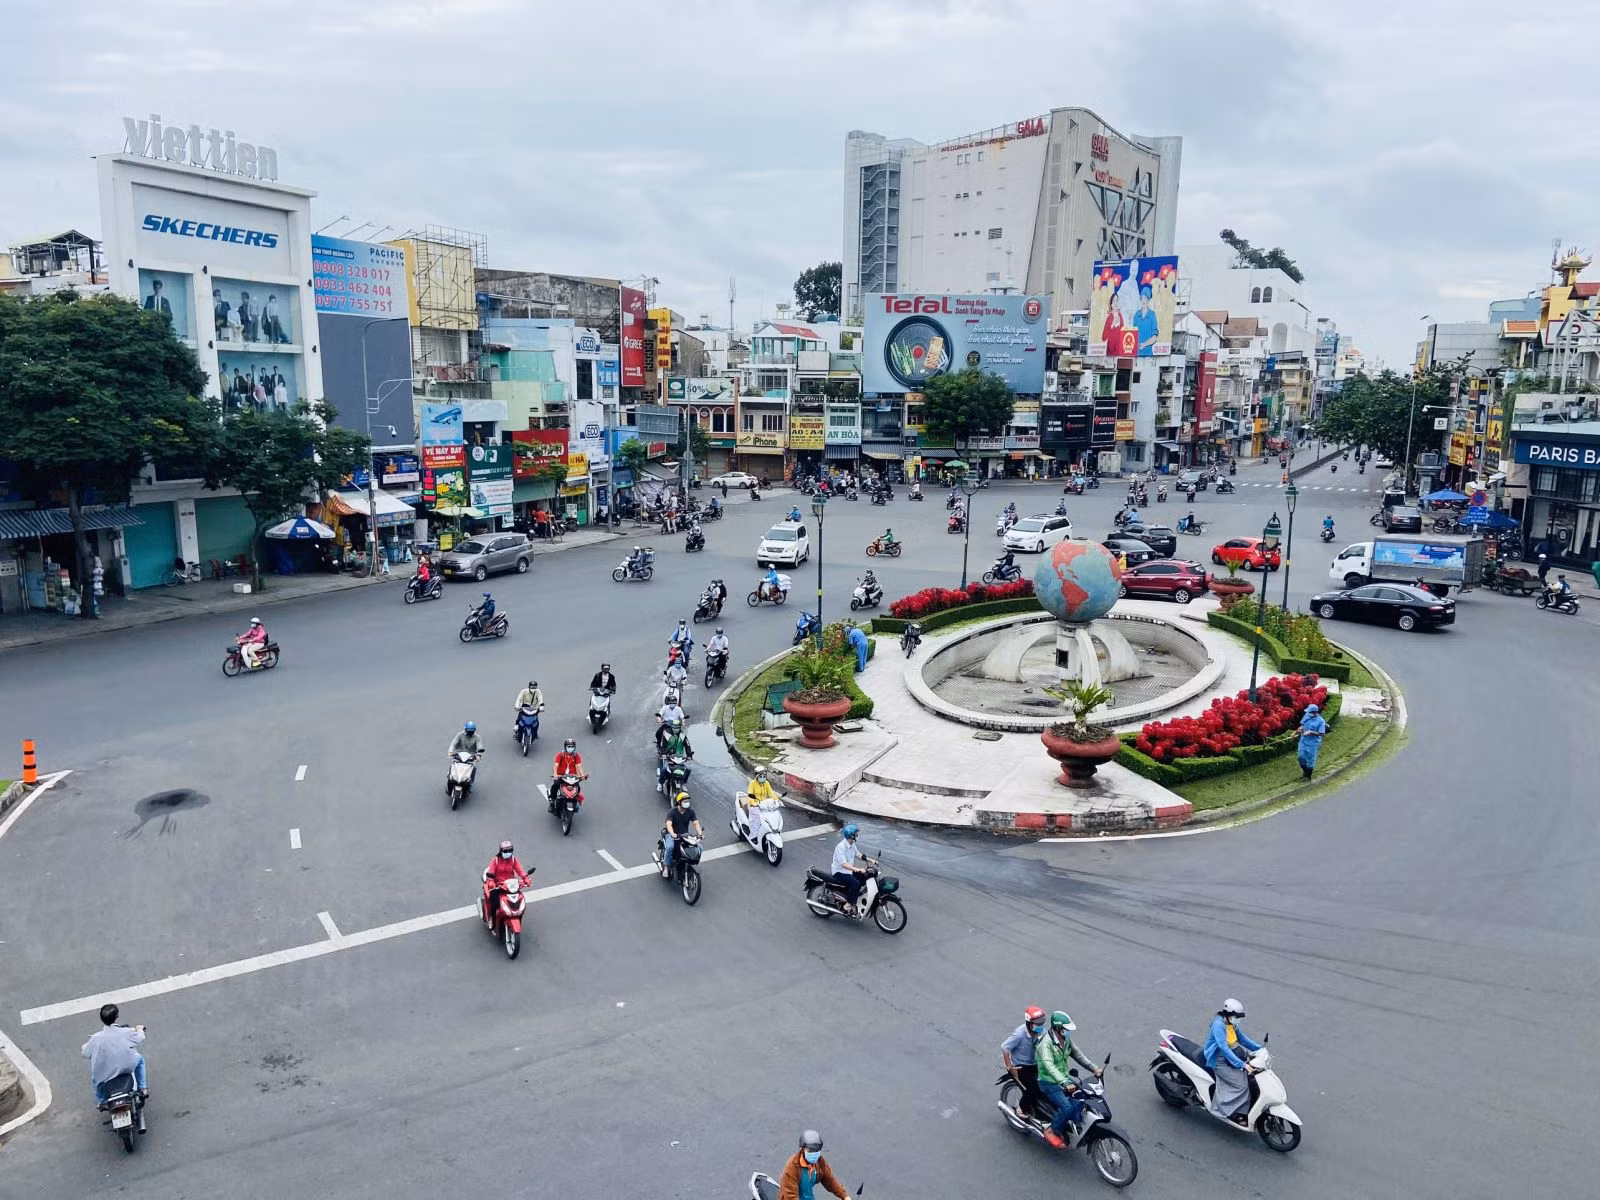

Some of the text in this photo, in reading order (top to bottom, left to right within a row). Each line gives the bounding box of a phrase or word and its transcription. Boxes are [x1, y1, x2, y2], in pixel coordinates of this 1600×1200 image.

[1017, 117, 1044, 134] GALA
[123, 113, 278, 179] viettien
[1092, 134, 1109, 154] GALA
[142, 214, 279, 249] SKECHERS
[369, 247, 405, 260] PACIFIC
[314, 260, 390, 281] 0908 328 017
[315, 277, 391, 297] 0933 462 404
[316, 294, 392, 312] 0977 755 751
[880, 295, 952, 314] Tefal
[582, 338, 594, 349] ECO
[629, 339, 642, 350] GREE
[587, 427, 599, 437] ECO
[827, 431, 839, 439] AN
[450, 446, 463, 454] BAY
[1529, 446, 1578, 463] PARIS
